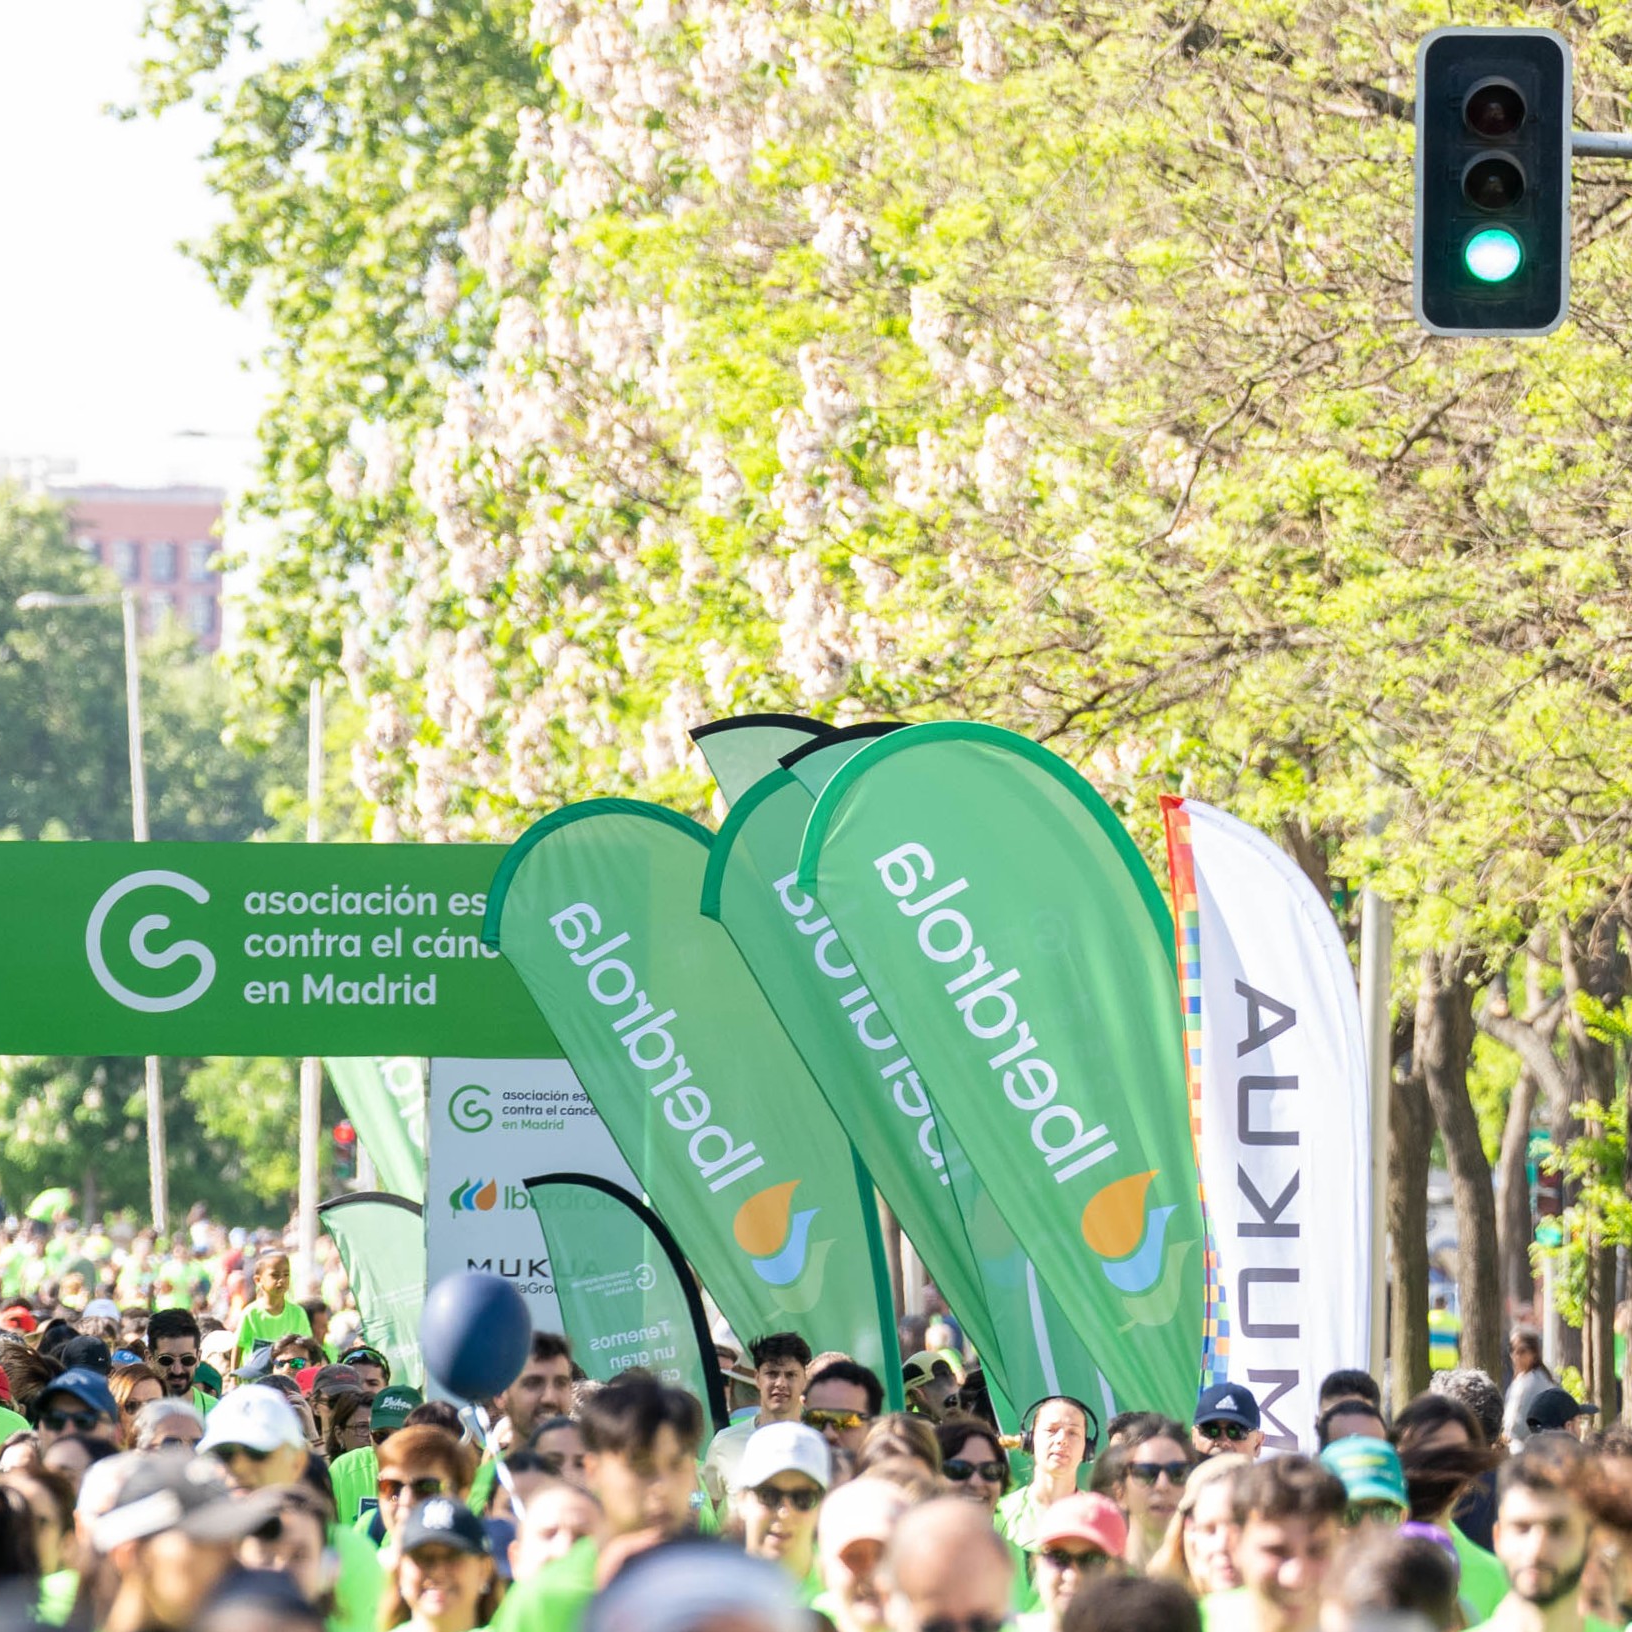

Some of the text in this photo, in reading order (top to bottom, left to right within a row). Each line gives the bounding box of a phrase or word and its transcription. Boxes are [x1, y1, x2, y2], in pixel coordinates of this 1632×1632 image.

[245, 885, 437, 915] asociación
[245, 928, 360, 957] contra
[372, 928, 401, 957] el
[244, 974, 436, 1005] en Madrid
[502, 1090, 569, 1101] asociación
[502, 1105, 543, 1115] contra
[546, 1105, 557, 1116] el
[502, 1120, 564, 1130] en Madrid
